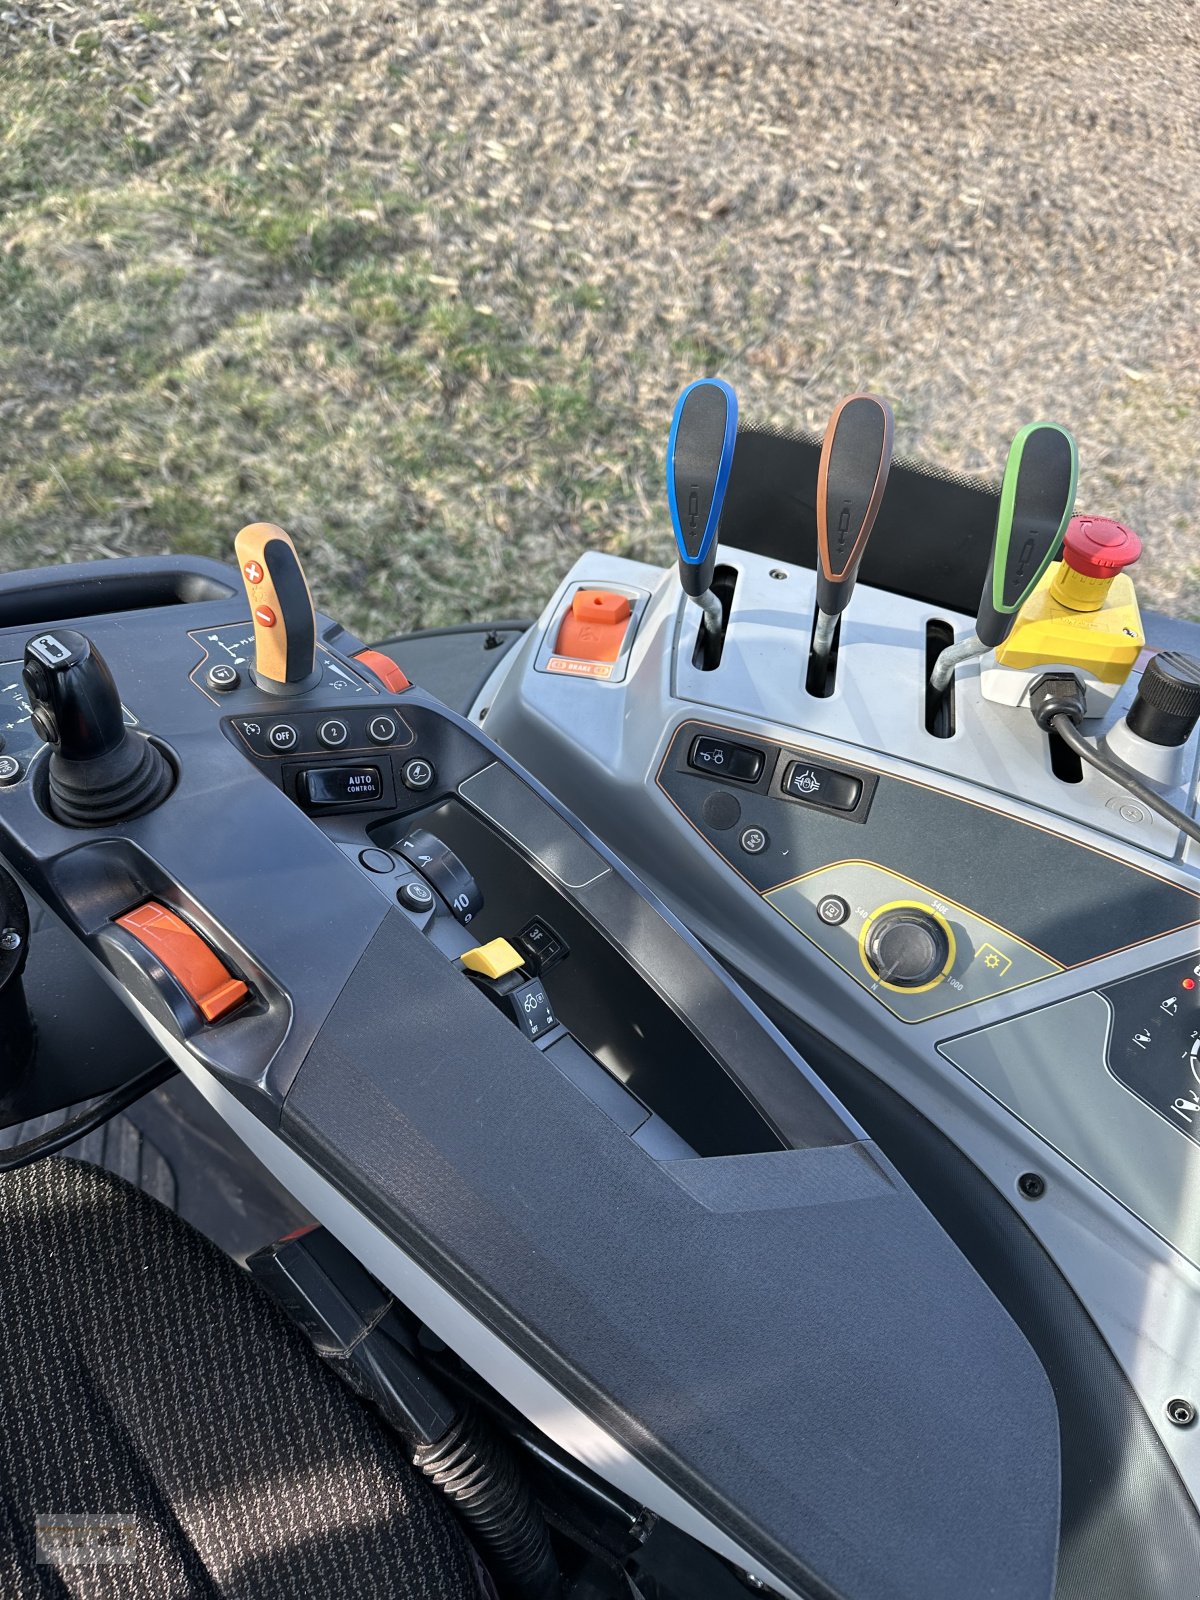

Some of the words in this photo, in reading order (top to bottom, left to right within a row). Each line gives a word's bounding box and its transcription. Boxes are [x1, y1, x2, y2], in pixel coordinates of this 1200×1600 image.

[568, 663, 593, 672] BRAKE
[275, 731, 290, 741] OFF
[331, 728, 337, 736] 2
[349, 775, 372, 785] AUTO
[347, 785, 375, 793] CONTROL
[453, 893, 469, 911] 10
[854, 906, 868, 919] 540
[931, 900, 949, 915] 540E
[870, 983, 879, 991] N
[948, 976, 964, 991] 1000
[1190, 1031, 1199, 1039] 2
